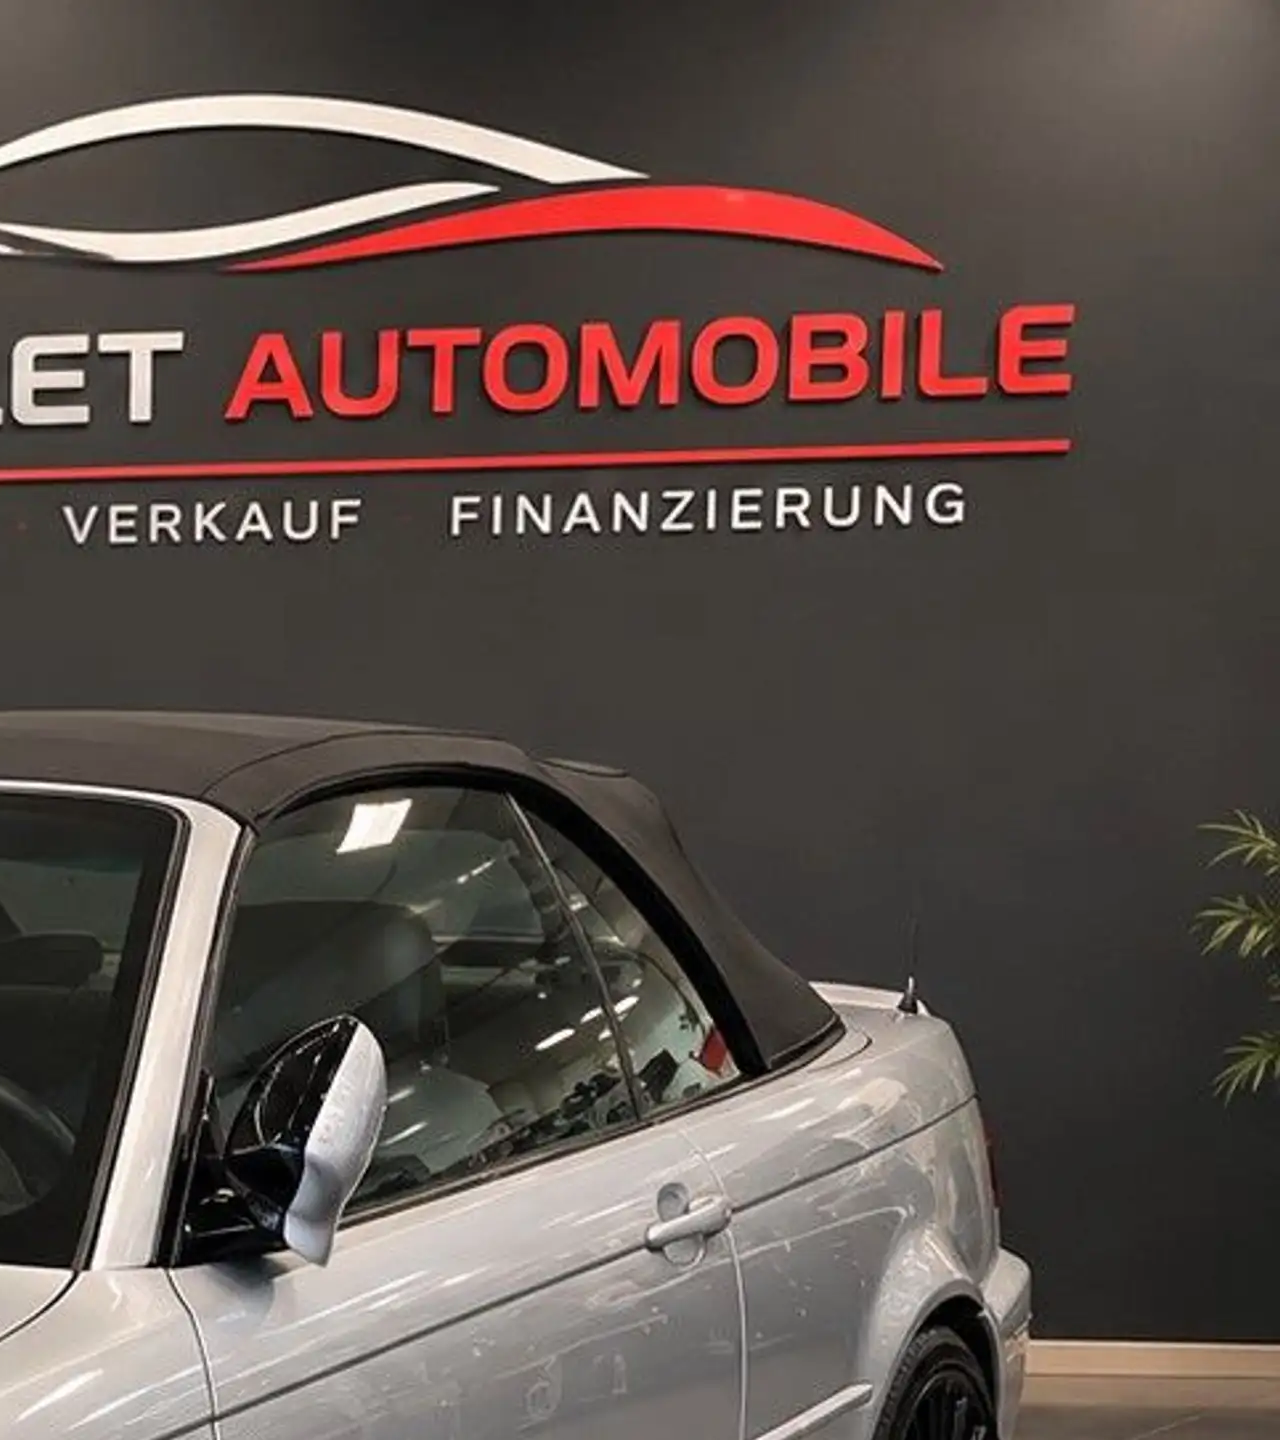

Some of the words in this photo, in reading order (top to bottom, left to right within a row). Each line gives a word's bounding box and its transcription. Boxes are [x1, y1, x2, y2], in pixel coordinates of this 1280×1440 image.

[224, 303, 1076, 419] AUTOMOBILE
[62, 498, 362, 545] VERKAUF
[451, 482, 966, 536] FINANZIERUNG
